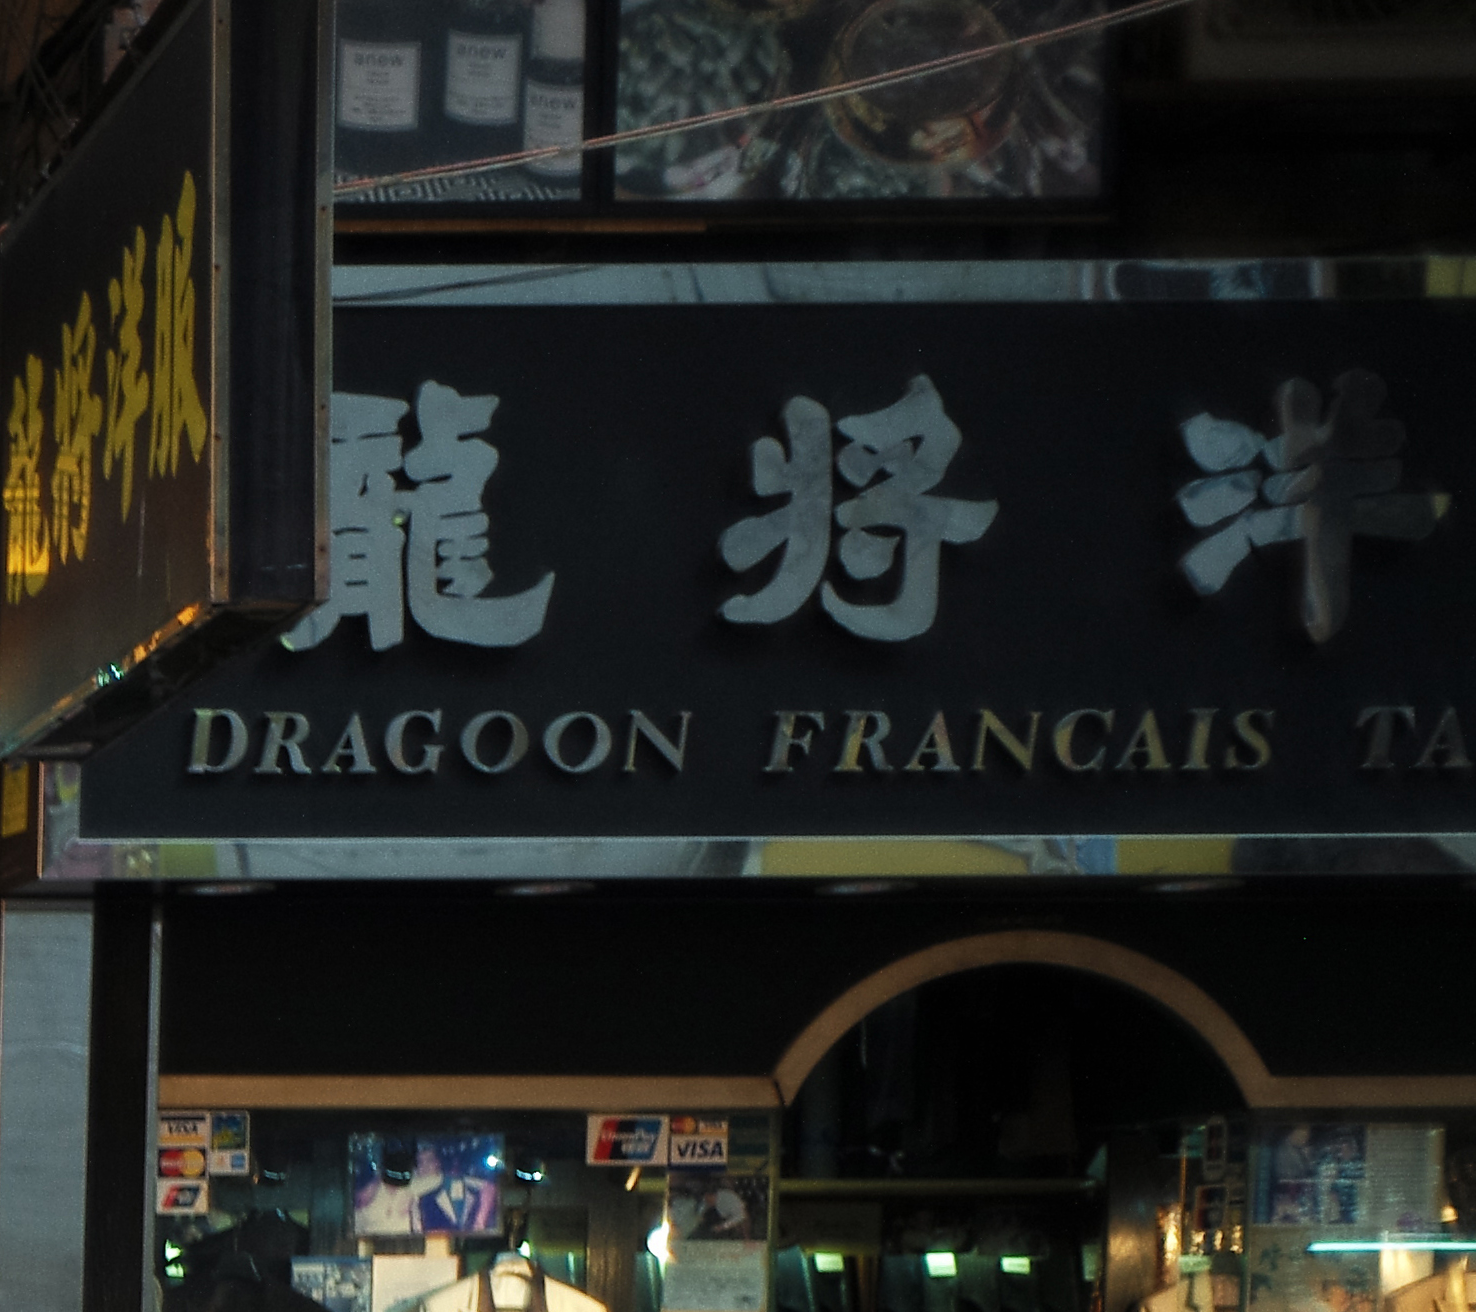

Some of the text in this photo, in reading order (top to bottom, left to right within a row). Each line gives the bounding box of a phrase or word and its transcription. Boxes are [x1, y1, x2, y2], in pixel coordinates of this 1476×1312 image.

[186, 706, 693, 777] DRAGOON
[763, 706, 1276, 772] FRANCAIS
[677, 1139, 724, 1159] VISA
